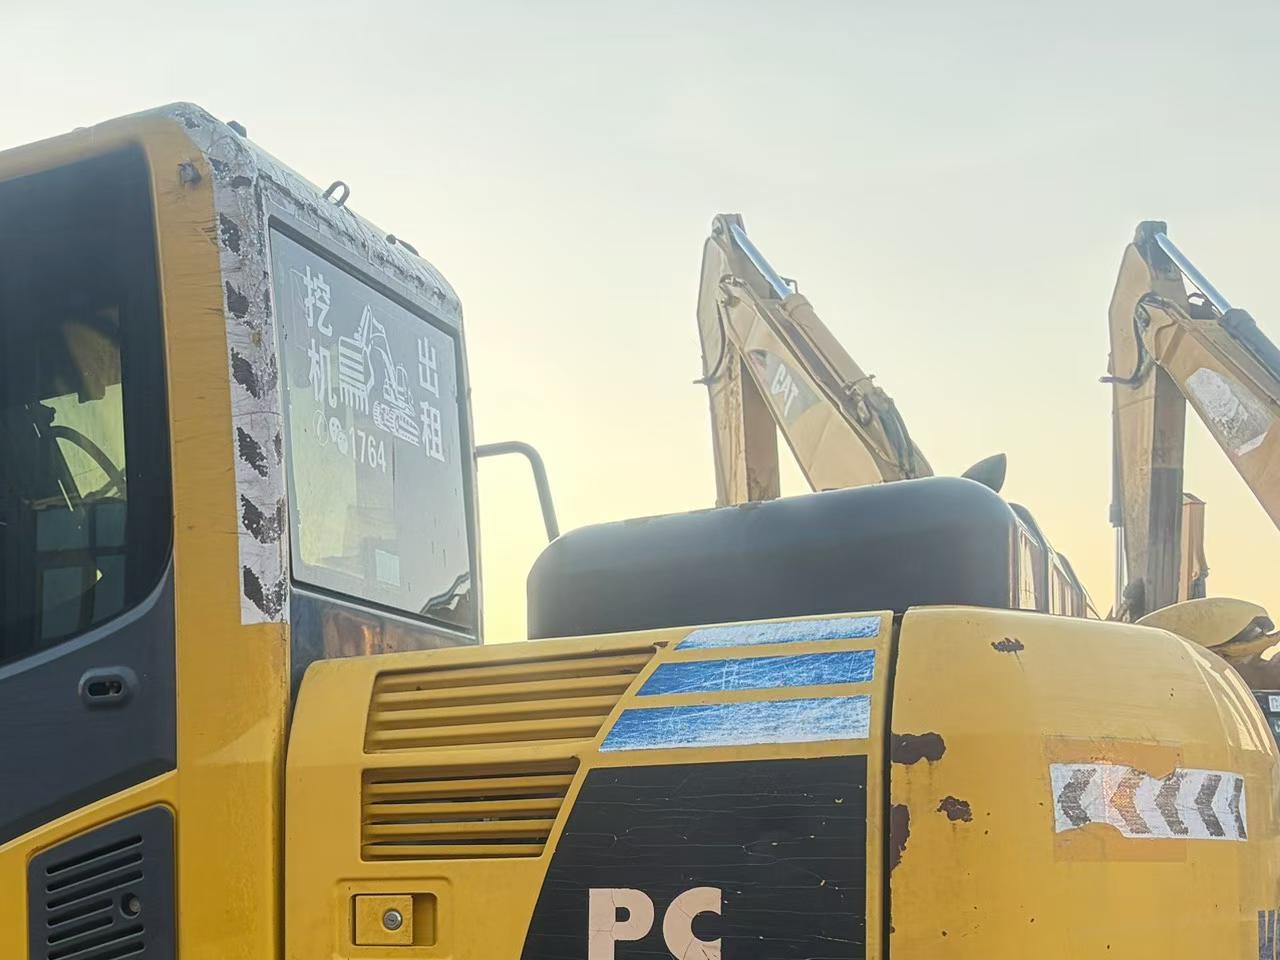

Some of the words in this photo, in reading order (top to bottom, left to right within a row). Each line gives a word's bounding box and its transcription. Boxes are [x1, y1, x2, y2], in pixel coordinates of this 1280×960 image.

[303, 264, 337, 408] 挖机
[418, 336, 445, 462] 出租
[771, 363, 800, 417] CAT
[349, 426, 386, 473] 1764
